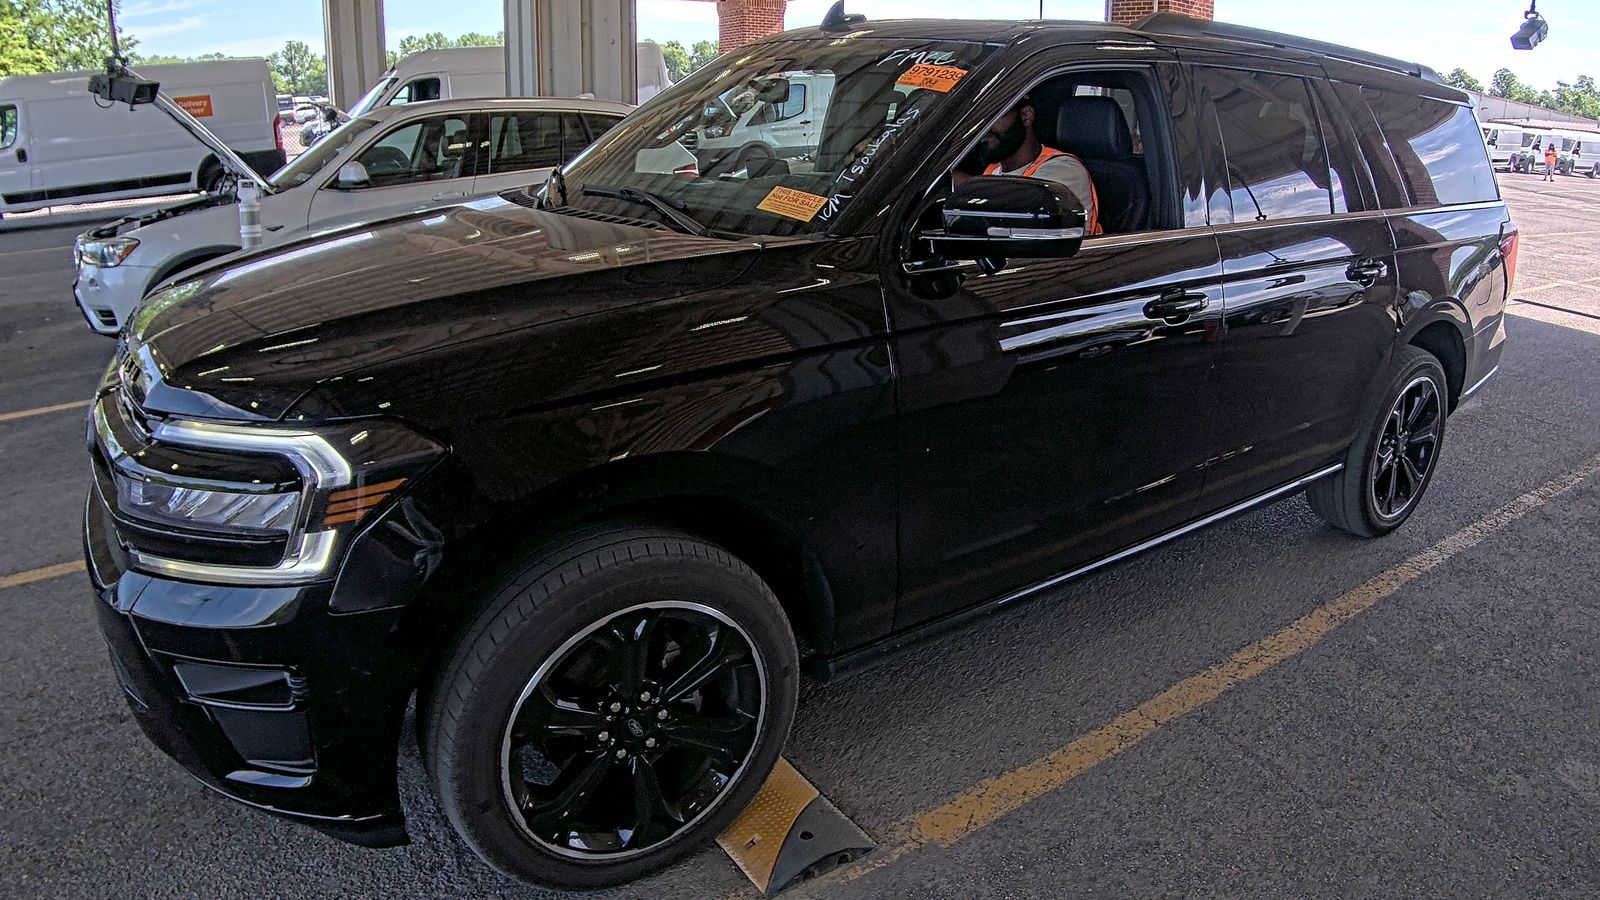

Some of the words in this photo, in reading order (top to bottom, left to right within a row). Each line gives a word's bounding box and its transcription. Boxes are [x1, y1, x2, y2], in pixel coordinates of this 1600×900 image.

[909, 65, 964, 81] 9791239
[776, 187, 792, 196] THIS
[793, 190, 825, 204] VEHICLE
[783, 195, 799, 205] FOR
[799, 199, 820, 209] SALE
